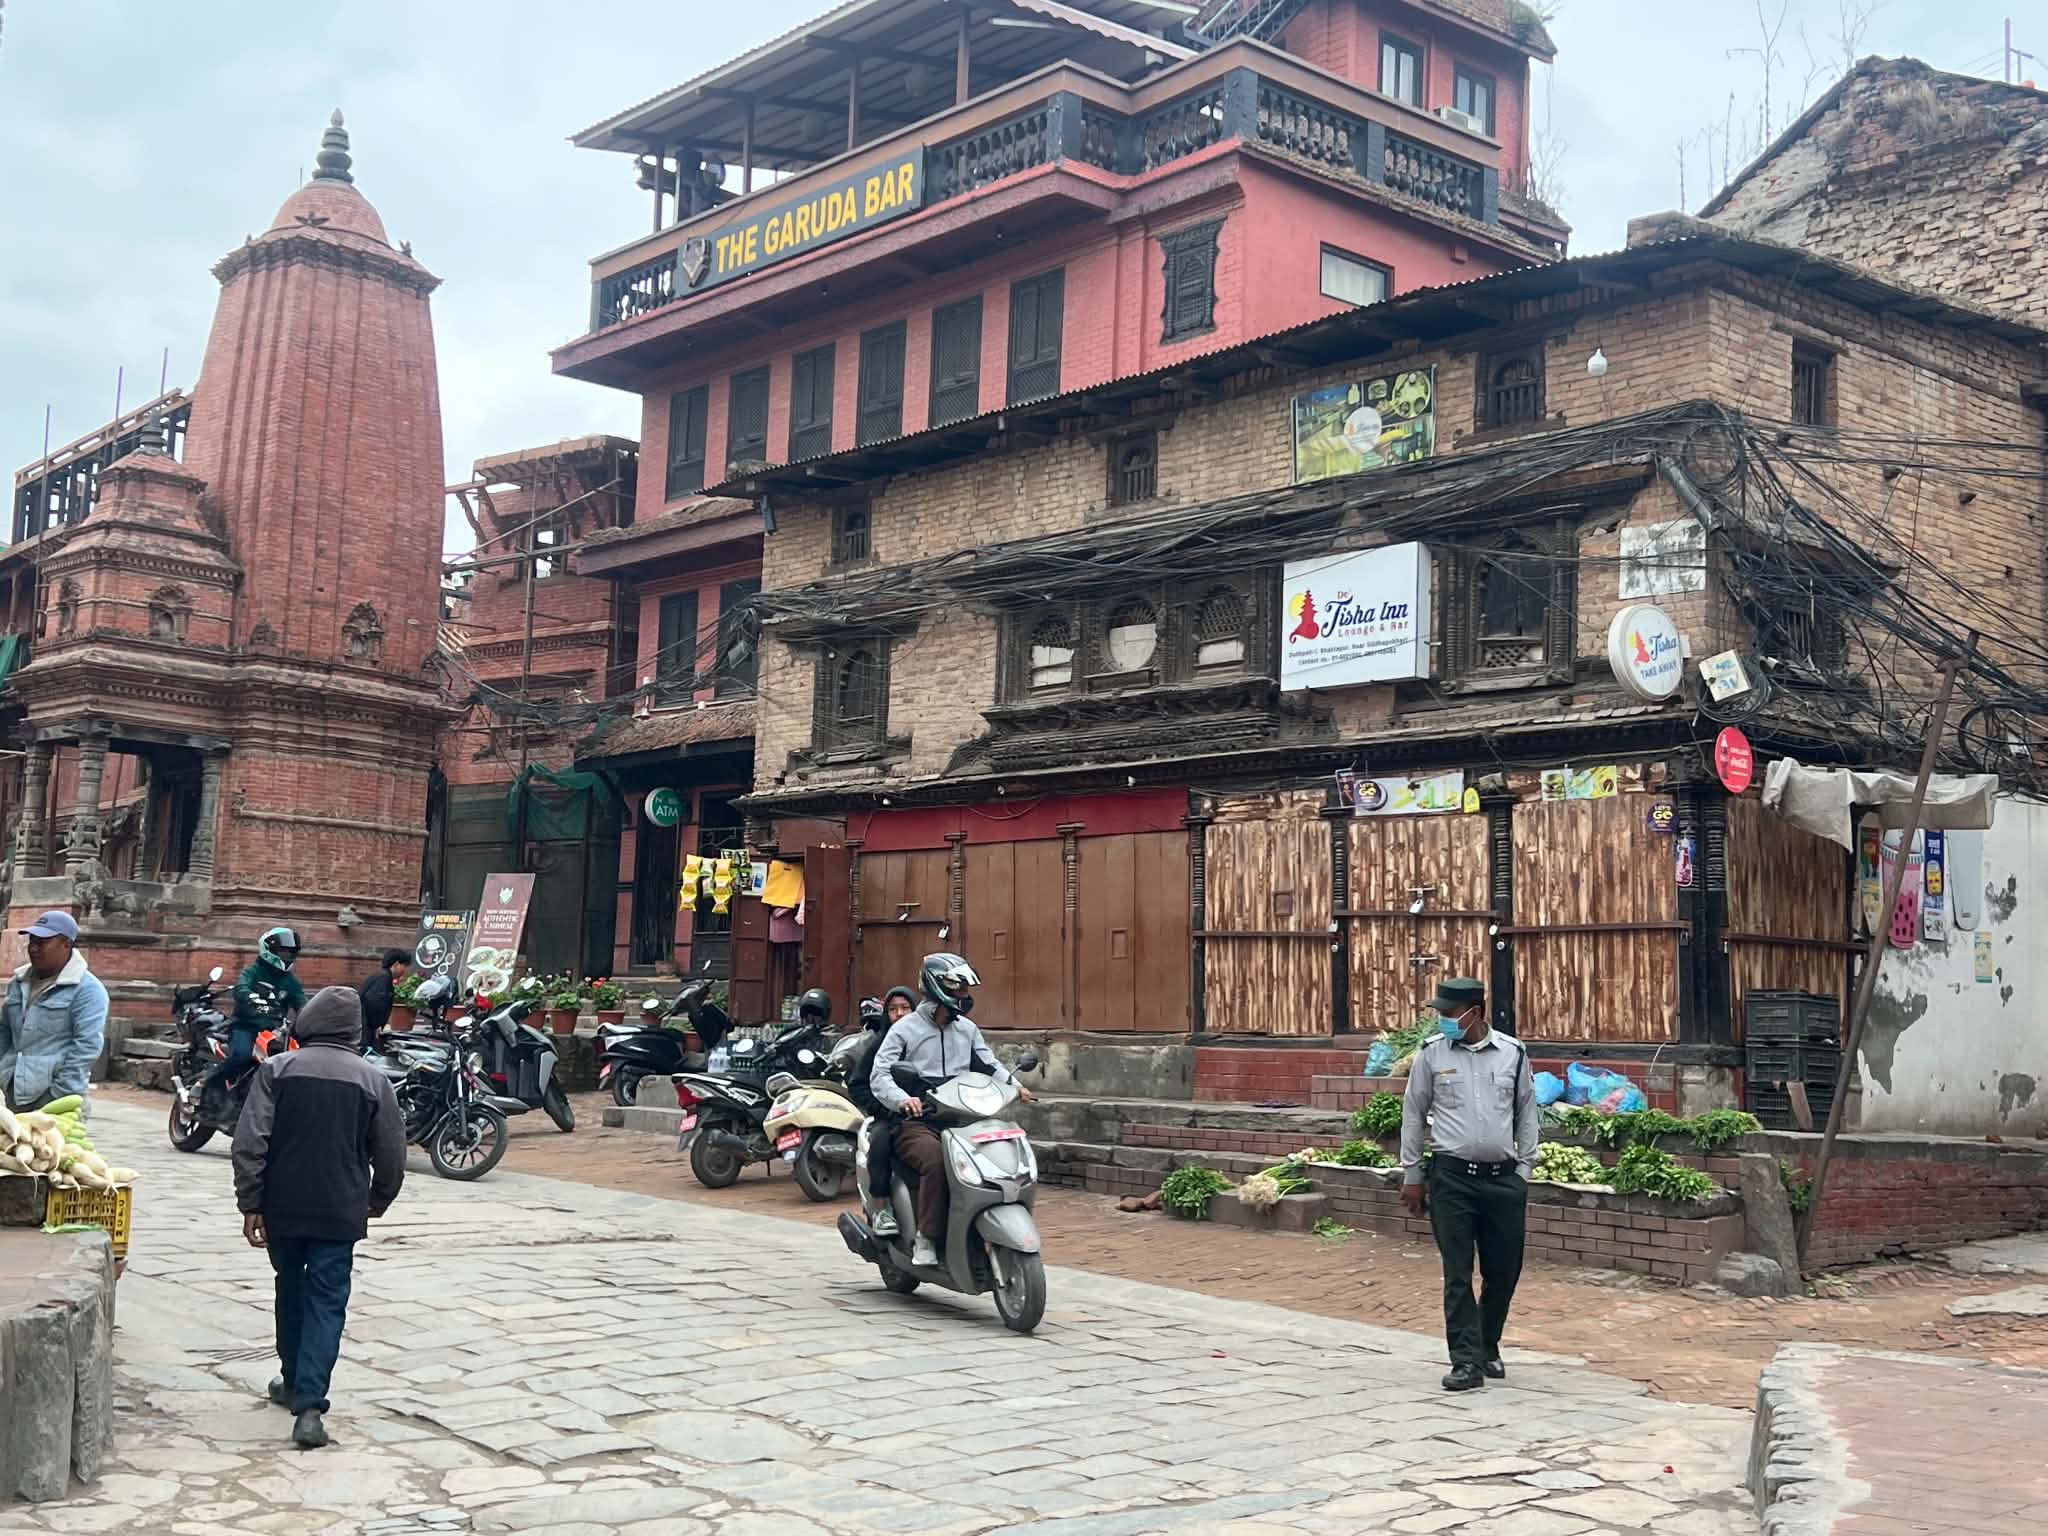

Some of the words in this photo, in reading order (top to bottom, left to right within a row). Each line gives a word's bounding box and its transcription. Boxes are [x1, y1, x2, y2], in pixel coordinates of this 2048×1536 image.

[715, 223, 759, 274] THE
[763, 187, 857, 256] GARUDA
[864, 162, 914, 218] BAR
[1321, 595, 1375, 638] Tisha
[1380, 601, 1409, 620] Inn
[1648, 632, 1678, 661] Tisha
[1640, 666, 1658, 680] TAKE
[1658, 659, 1679, 674] AWAY
[656, 805, 678, 817] ATM
[1653, 810, 1673, 820] GO
